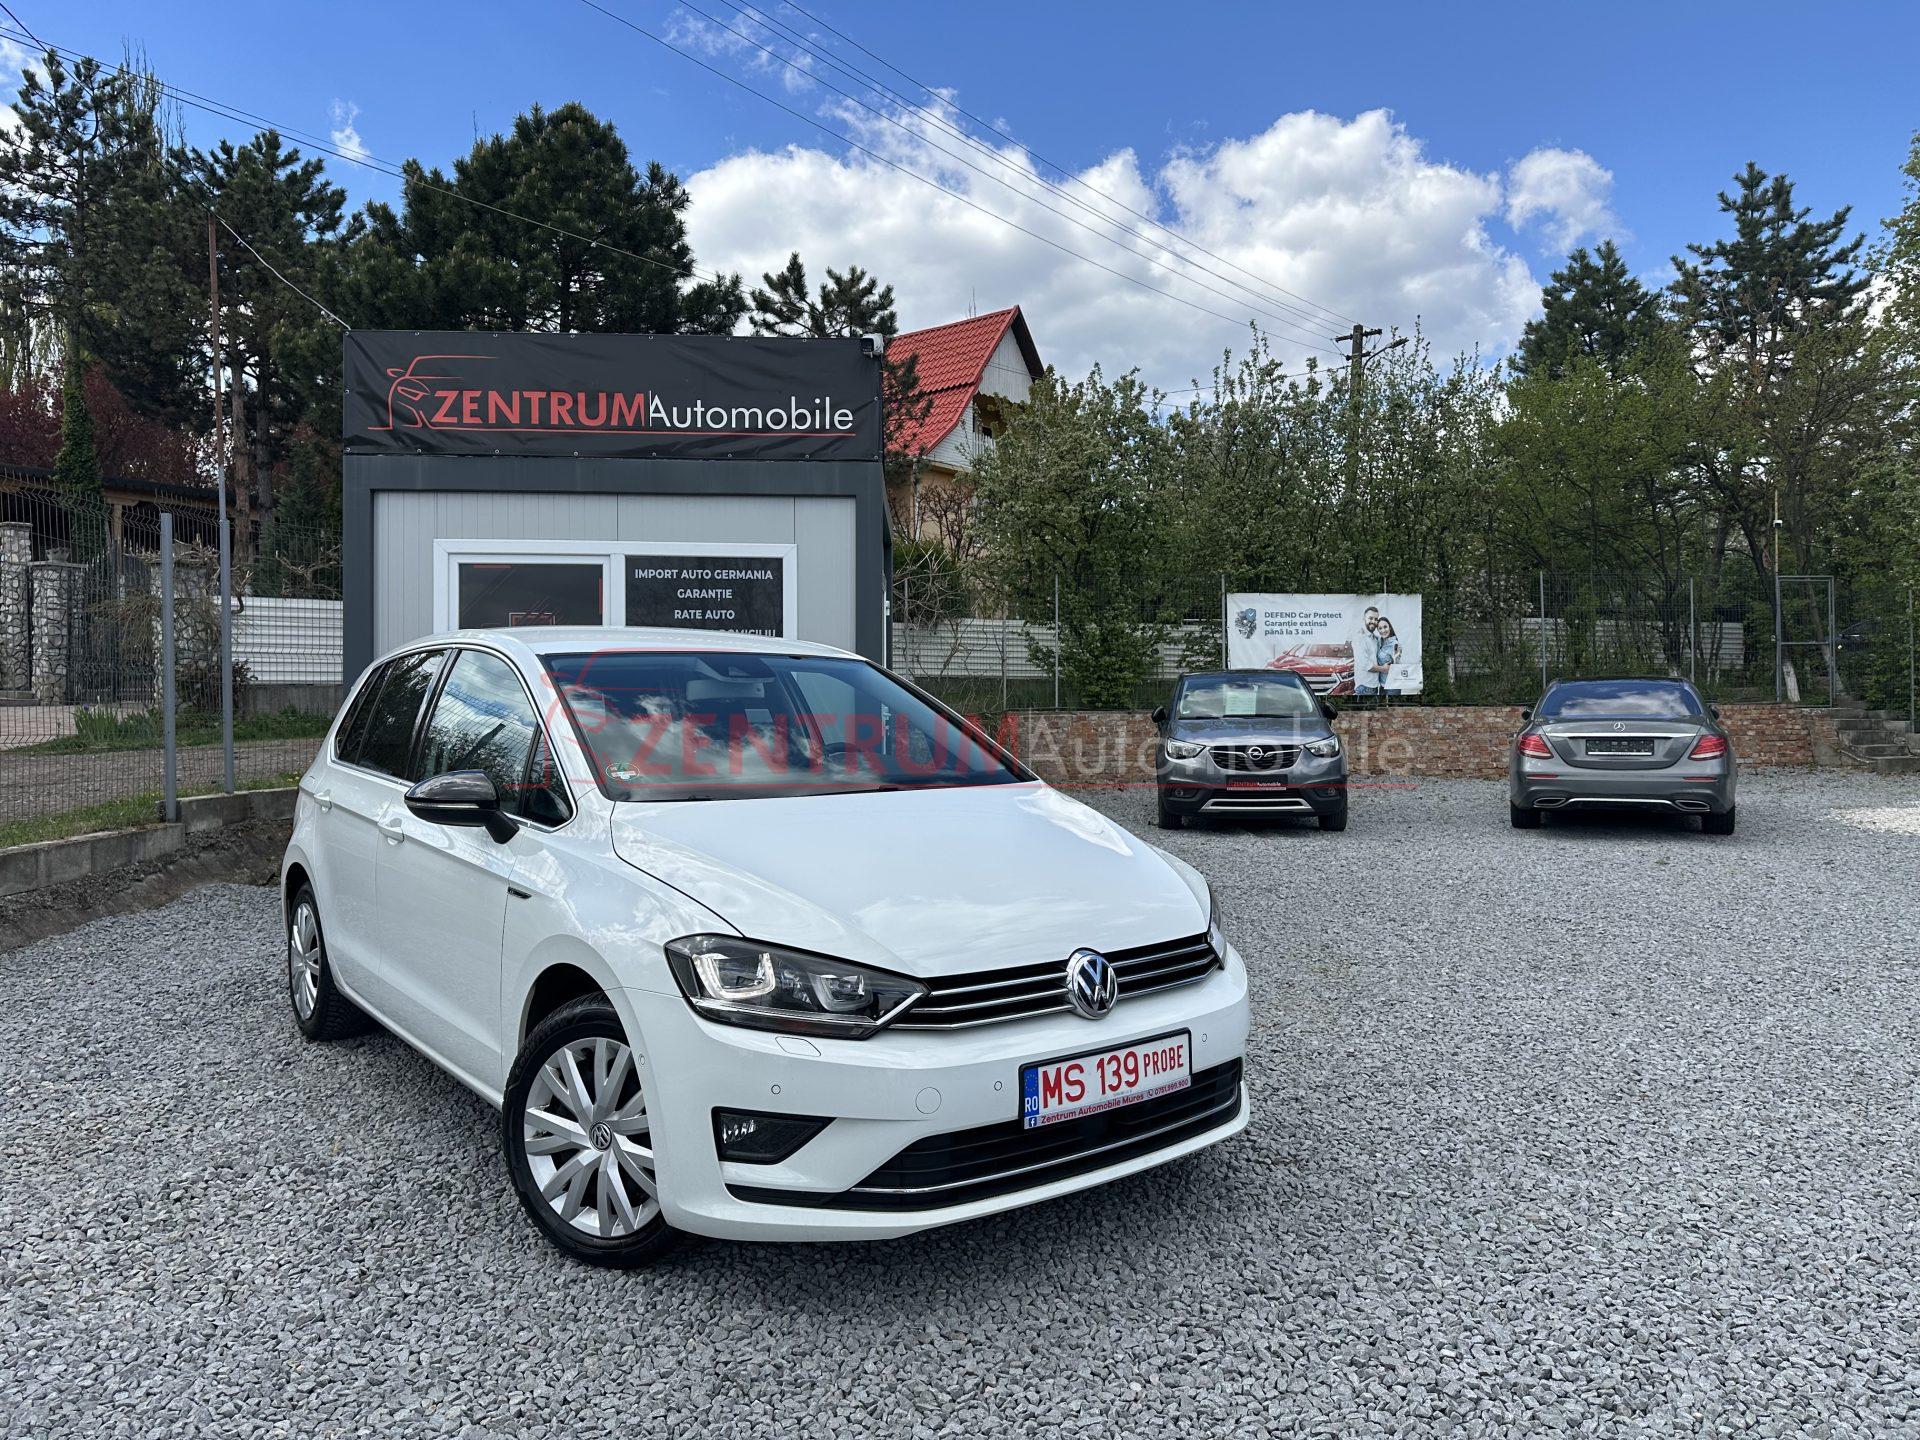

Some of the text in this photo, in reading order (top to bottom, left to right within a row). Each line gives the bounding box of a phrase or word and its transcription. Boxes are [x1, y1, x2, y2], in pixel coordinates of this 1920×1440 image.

[432, 389, 855, 431] ZENTRUM Automobile
[635, 568, 774, 581] IMPORT AUTO GERMANIA
[677, 589, 733, 602] GARANȚIE
[674, 609, 736, 620] RATE AUTO
[1264, 611, 1342, 619] DEFEND Car Protect
[1264, 620, 1328, 628] Garanție extinsă
[1285, 628, 1293, 636] la
[1294, 628, 1300, 636] 3
[1301, 628, 1314, 636] ani
[1041, 1044, 1184, 1109] MS 139 PROBE
[1024, 1095, 1039, 1113] RO
[1041, 1109, 1077, 1125] Zentrum
[1078, 1098, 1121, 1116] Automobile
